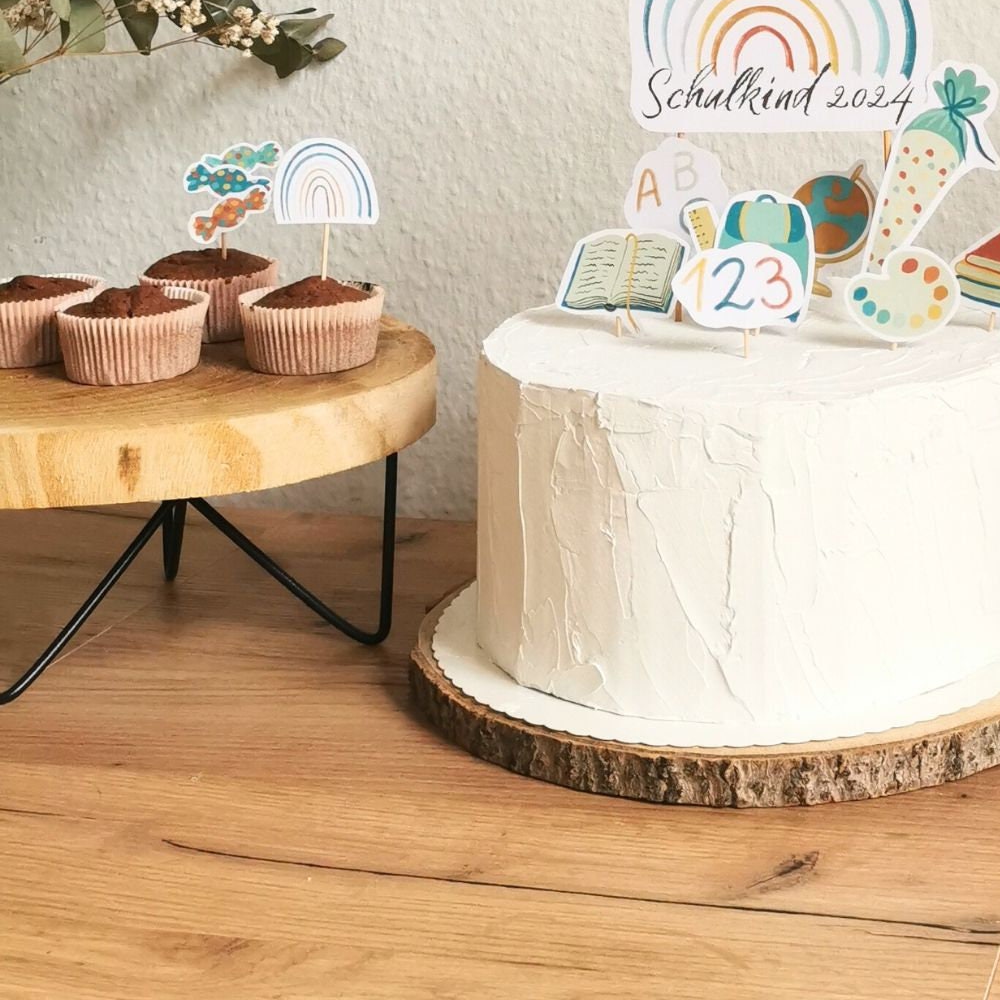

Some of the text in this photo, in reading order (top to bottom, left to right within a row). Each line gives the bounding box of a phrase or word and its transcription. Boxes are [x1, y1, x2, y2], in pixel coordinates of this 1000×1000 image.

[642, 62, 914, 125] Schulkind 2024
[680, 256, 793, 312] 123
